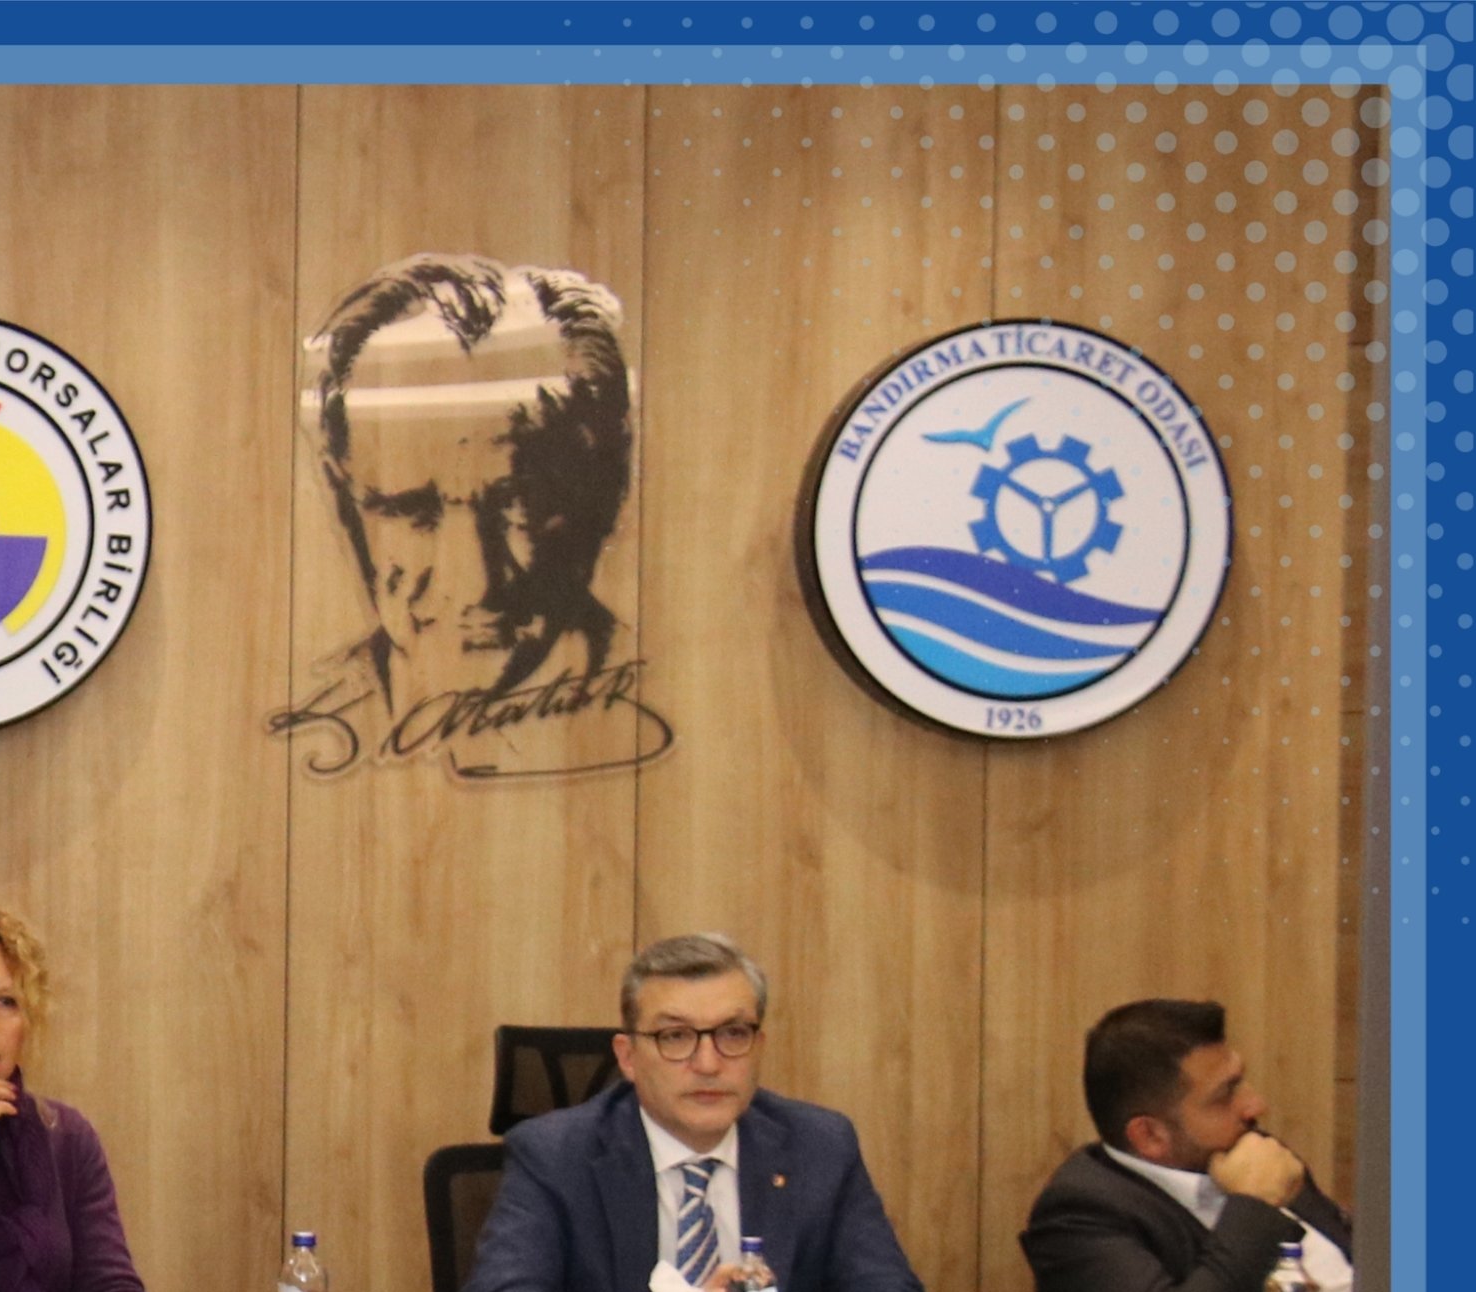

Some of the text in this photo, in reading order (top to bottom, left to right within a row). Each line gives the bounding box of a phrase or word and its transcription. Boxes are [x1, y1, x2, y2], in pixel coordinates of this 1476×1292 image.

[836, 325, 1208, 471] BANDIRMA TİCARET ODASI
[39, 534, 133, 684] BİRLİĞİ
[984, 706, 1043, 730] 1926
